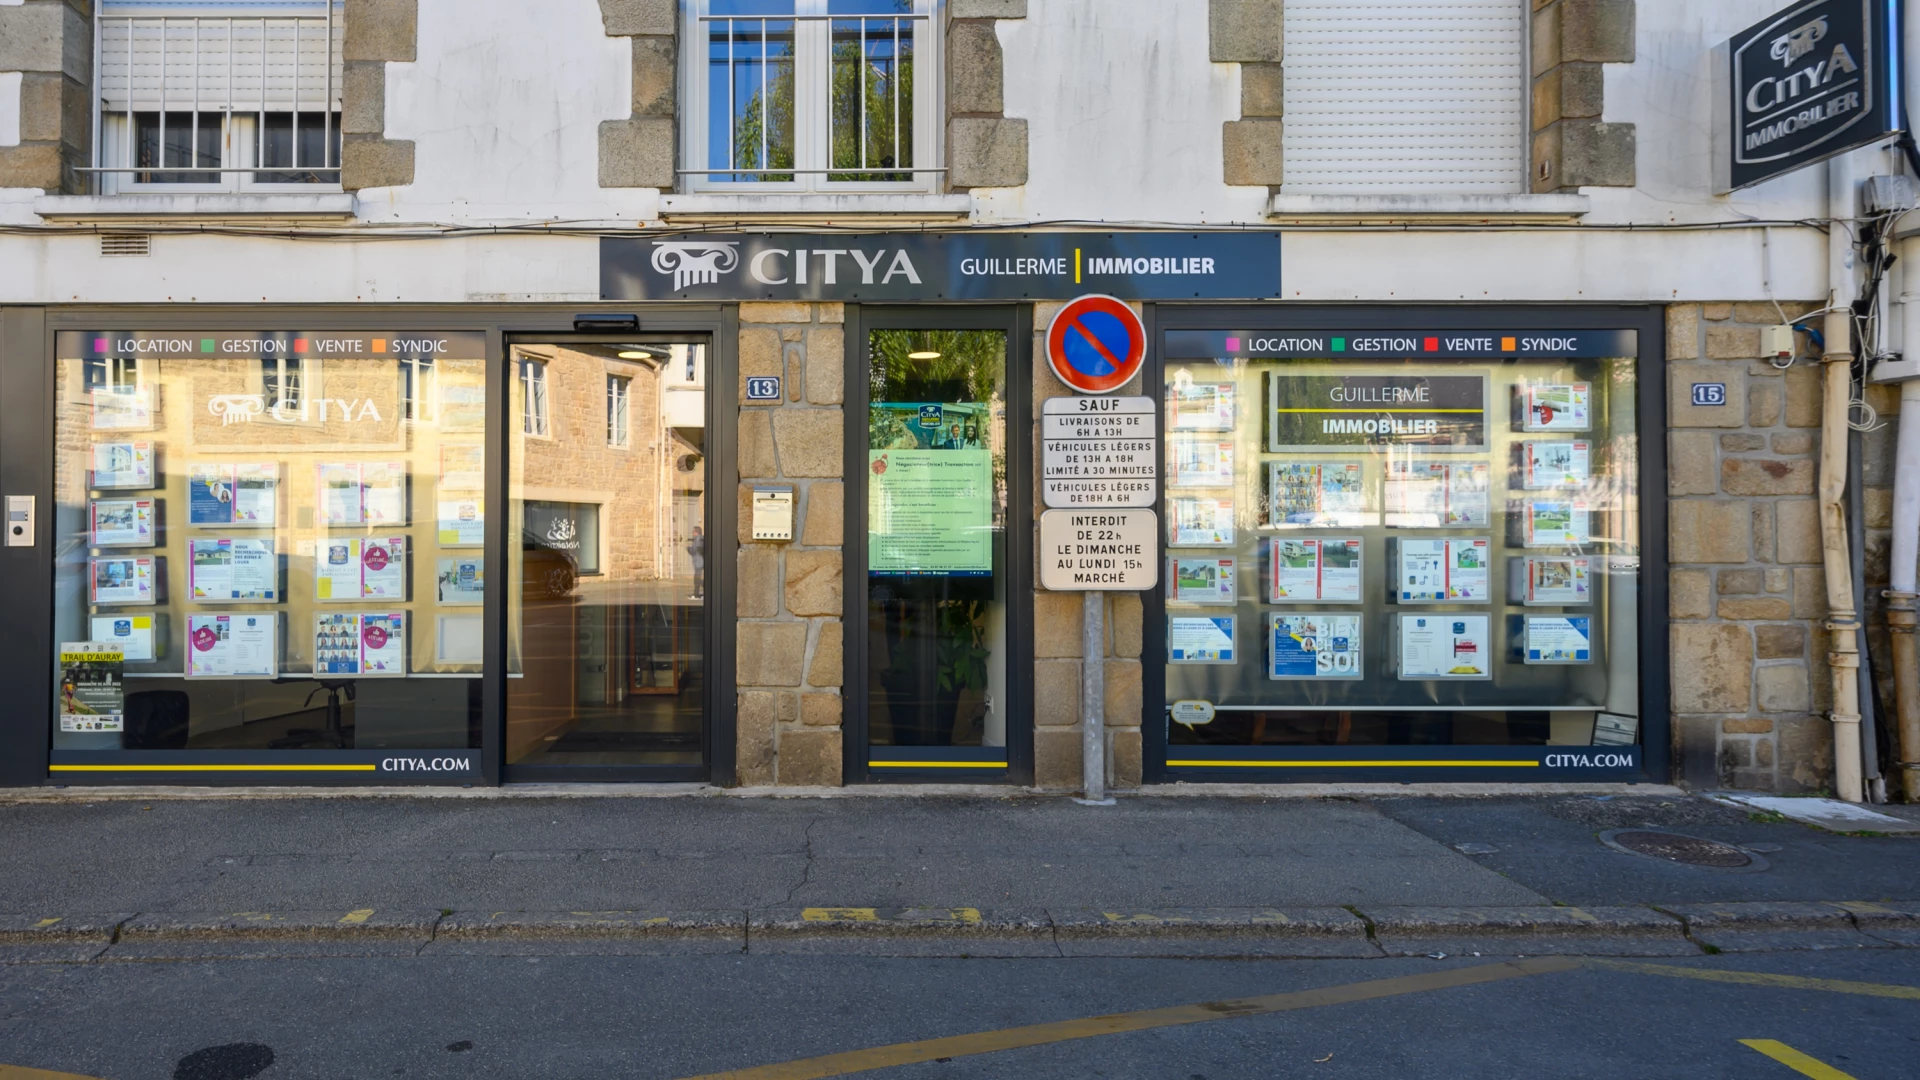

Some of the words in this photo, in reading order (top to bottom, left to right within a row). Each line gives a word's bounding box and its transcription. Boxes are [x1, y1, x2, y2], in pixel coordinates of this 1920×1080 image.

[1746, 92, 1858, 150] IMMOBILIER
[751, 249, 922, 284] CITYA
[960, 258, 1066, 274] GUILLERME
[1088, 258, 1214, 274] IMMOBILIER
[118, 340, 192, 352] LOCATION
[222, 340, 286, 352] GESTION
[316, 340, 362, 352] VENTE
[392, 340, 447, 352] SYNDIC
[1249, 339, 1322, 351] LOCATION
[1352, 338, 1416, 351] GESTION
[1446, 338, 1492, 351] VENTE
[1522, 338, 1576, 351] SYNDIC
[753, 381, 773, 395] 13
[1698, 387, 1720, 401] 15
[1330, 387, 1429, 402] GUILLERME
[272, 398, 381, 422] CITYA
[1080, 399, 1120, 411] SAUF
[1060, 418, 1122, 426] LIVRAISONS
[1127, 417, 1139, 425] DE
[1323, 419, 1437, 434] IMMOBILIER
[1105, 428, 1122, 436] 13H
[1048, 442, 1106, 451] VÉHICULES
[1111, 442, 1151, 451] LÉGERS
[1066, 455, 1078, 463] DE
[1046, 465, 1079, 474] LIMITÉ
[1110, 466, 1154, 474] MINUTES
[1050, 482, 1106, 492] VÉHICULES
[1111, 482, 1150, 491] LÉGERS
[1086, 494, 1102, 502] 18H
[1107, 494, 1112, 502] A
[1117, 494, 1129, 502] 6H
[1072, 516, 1127, 526] INTERDIT
[1077, 531, 1092, 540] DE
[1058, 545, 1071, 554] LE
[1077, 544, 1141, 554] DIMANCHE
[1057, 559, 1073, 568] AU
[1080, 558, 1115, 568] LUNDI
[1124, 560, 1142, 569] 15h
[1074, 571, 1125, 582] MARCHÉ
[1317, 651, 1359, 672] SOI
[382, 758, 470, 771] CITYA.COM
[1545, 754, 1633, 767] CITYA.COM
